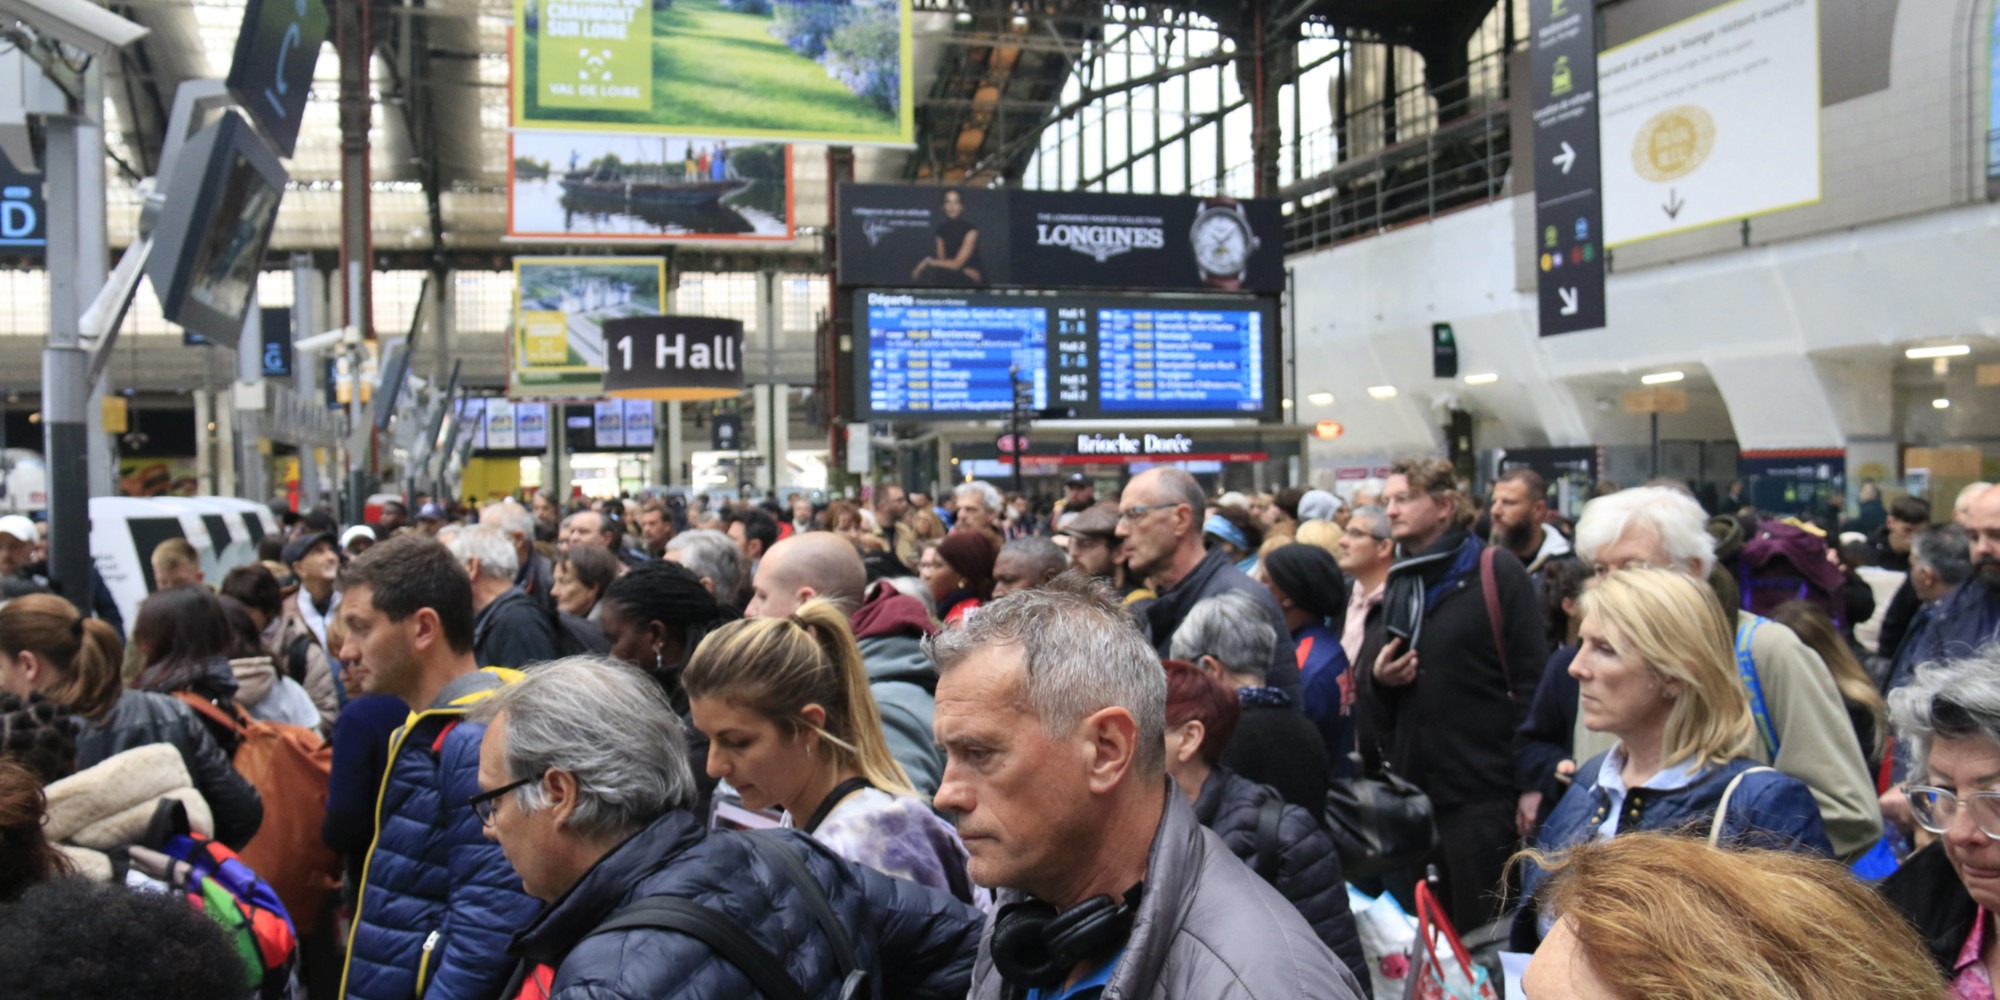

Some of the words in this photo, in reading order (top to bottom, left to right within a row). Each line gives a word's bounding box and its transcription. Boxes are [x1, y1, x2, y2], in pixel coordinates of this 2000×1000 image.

[546, 3, 635, 23] CHAUMONT
[547, 20, 580, 37] SUR
[582, 22, 628, 40] LOIRE
[548, 82, 575, 96] VAL
[578, 84, 597, 97] DE
[600, 85, 641, 99] LOIRE
[0, 200, 37, 238] D
[1036, 224, 1164, 249] LONGINES
[868, 293, 914, 307] Départs
[617, 335, 633, 371] 1
[655, 333, 736, 371] Hall
[1077, 433, 1140, 455] Brioche
[1144, 433, 1193, 454] Dorée
